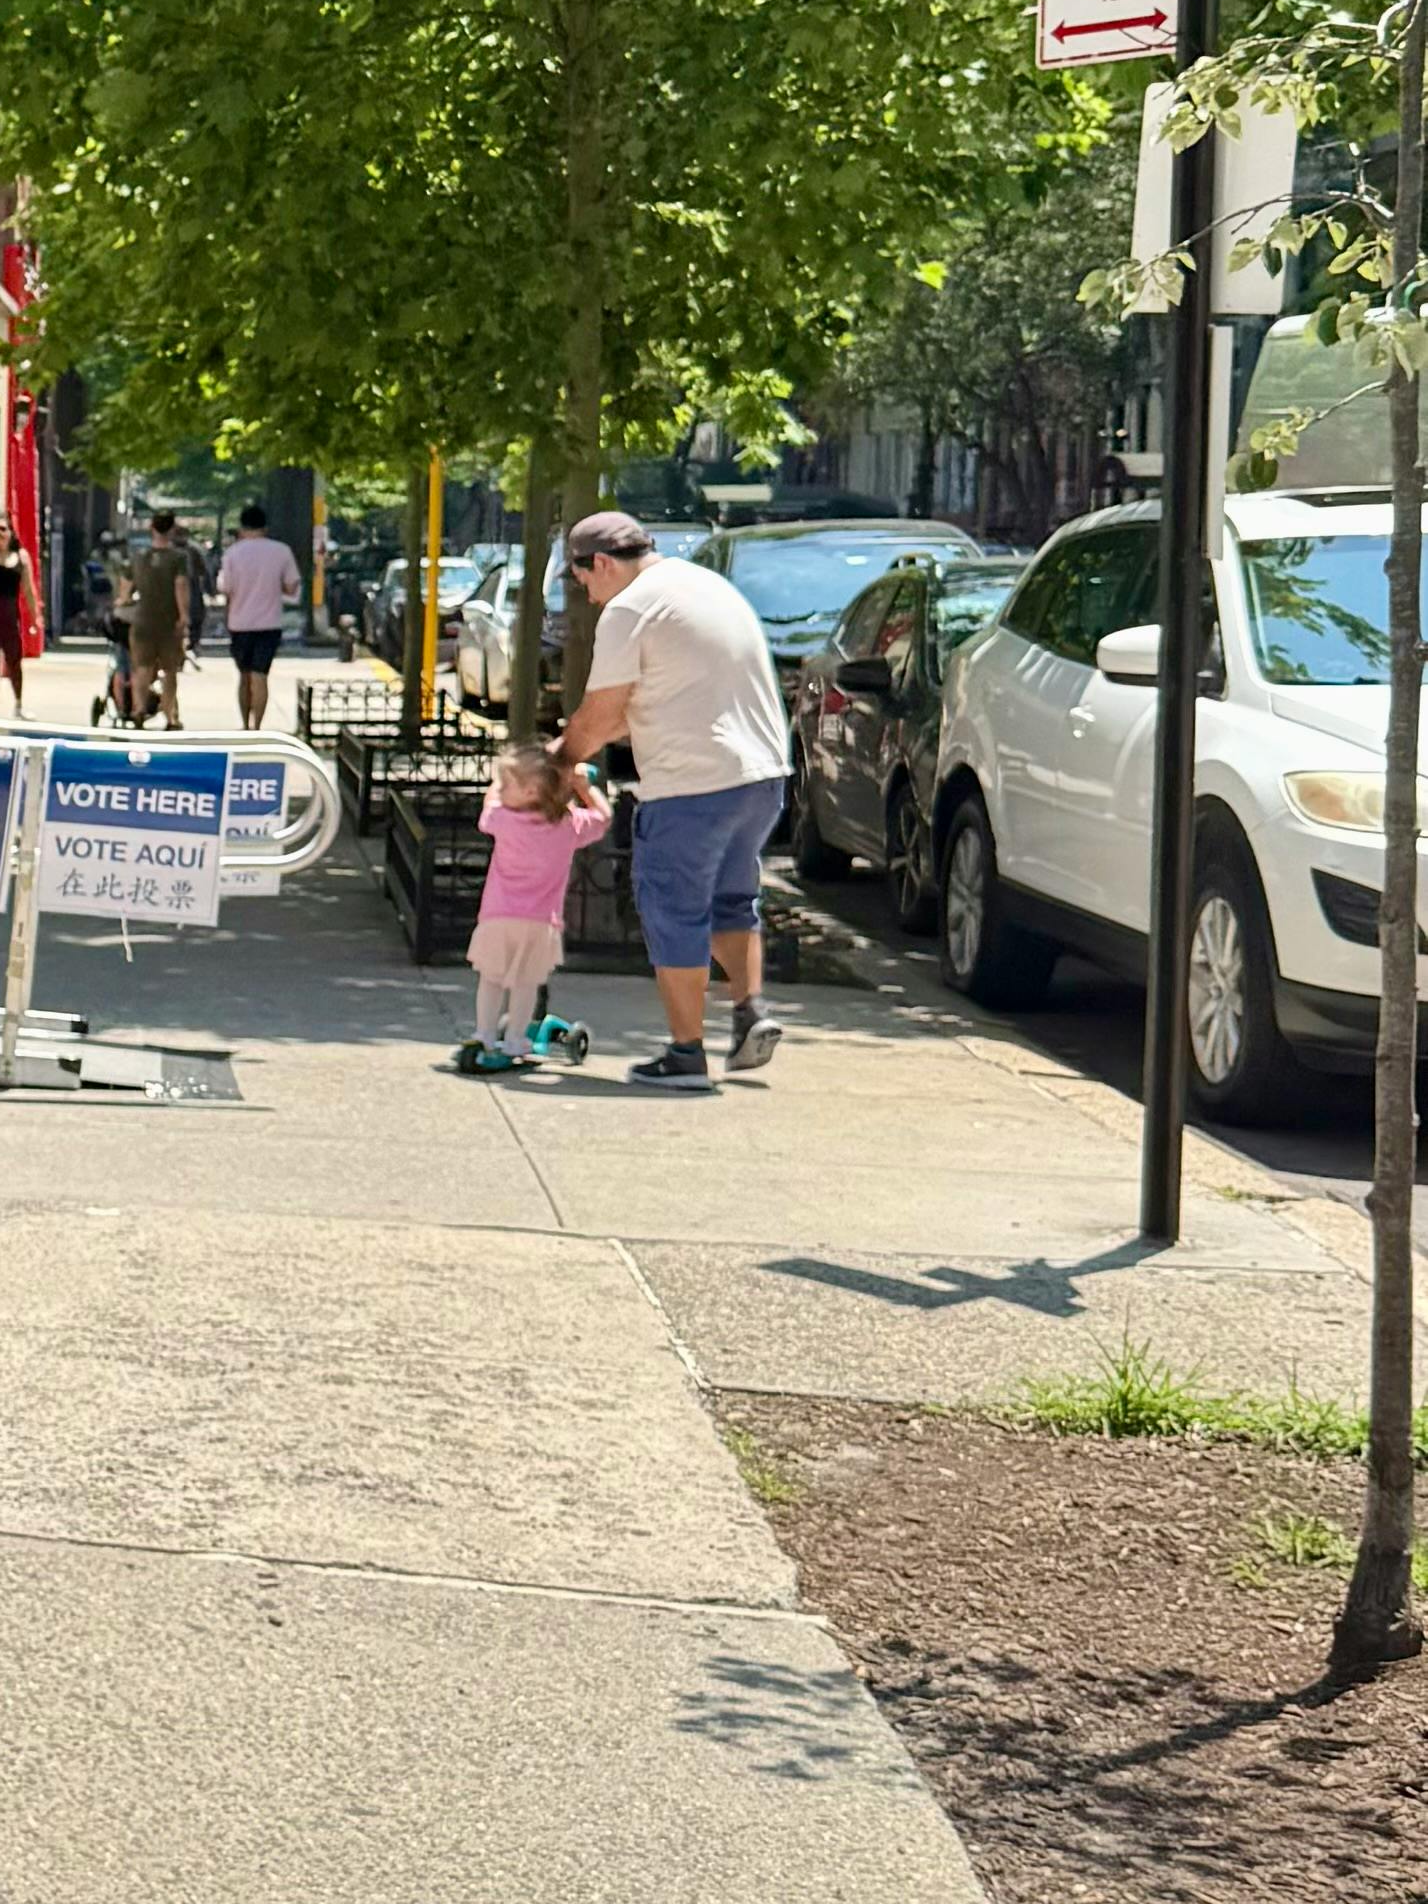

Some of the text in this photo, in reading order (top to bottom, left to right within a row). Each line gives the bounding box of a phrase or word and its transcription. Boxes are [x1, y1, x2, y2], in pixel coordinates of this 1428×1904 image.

[55, 780, 217, 819] VOTE HERE
[227, 779, 278, 802] ERE
[55, 836, 206, 869] VOTE AQUÍ
[56, 868, 195, 910] 在此投票
